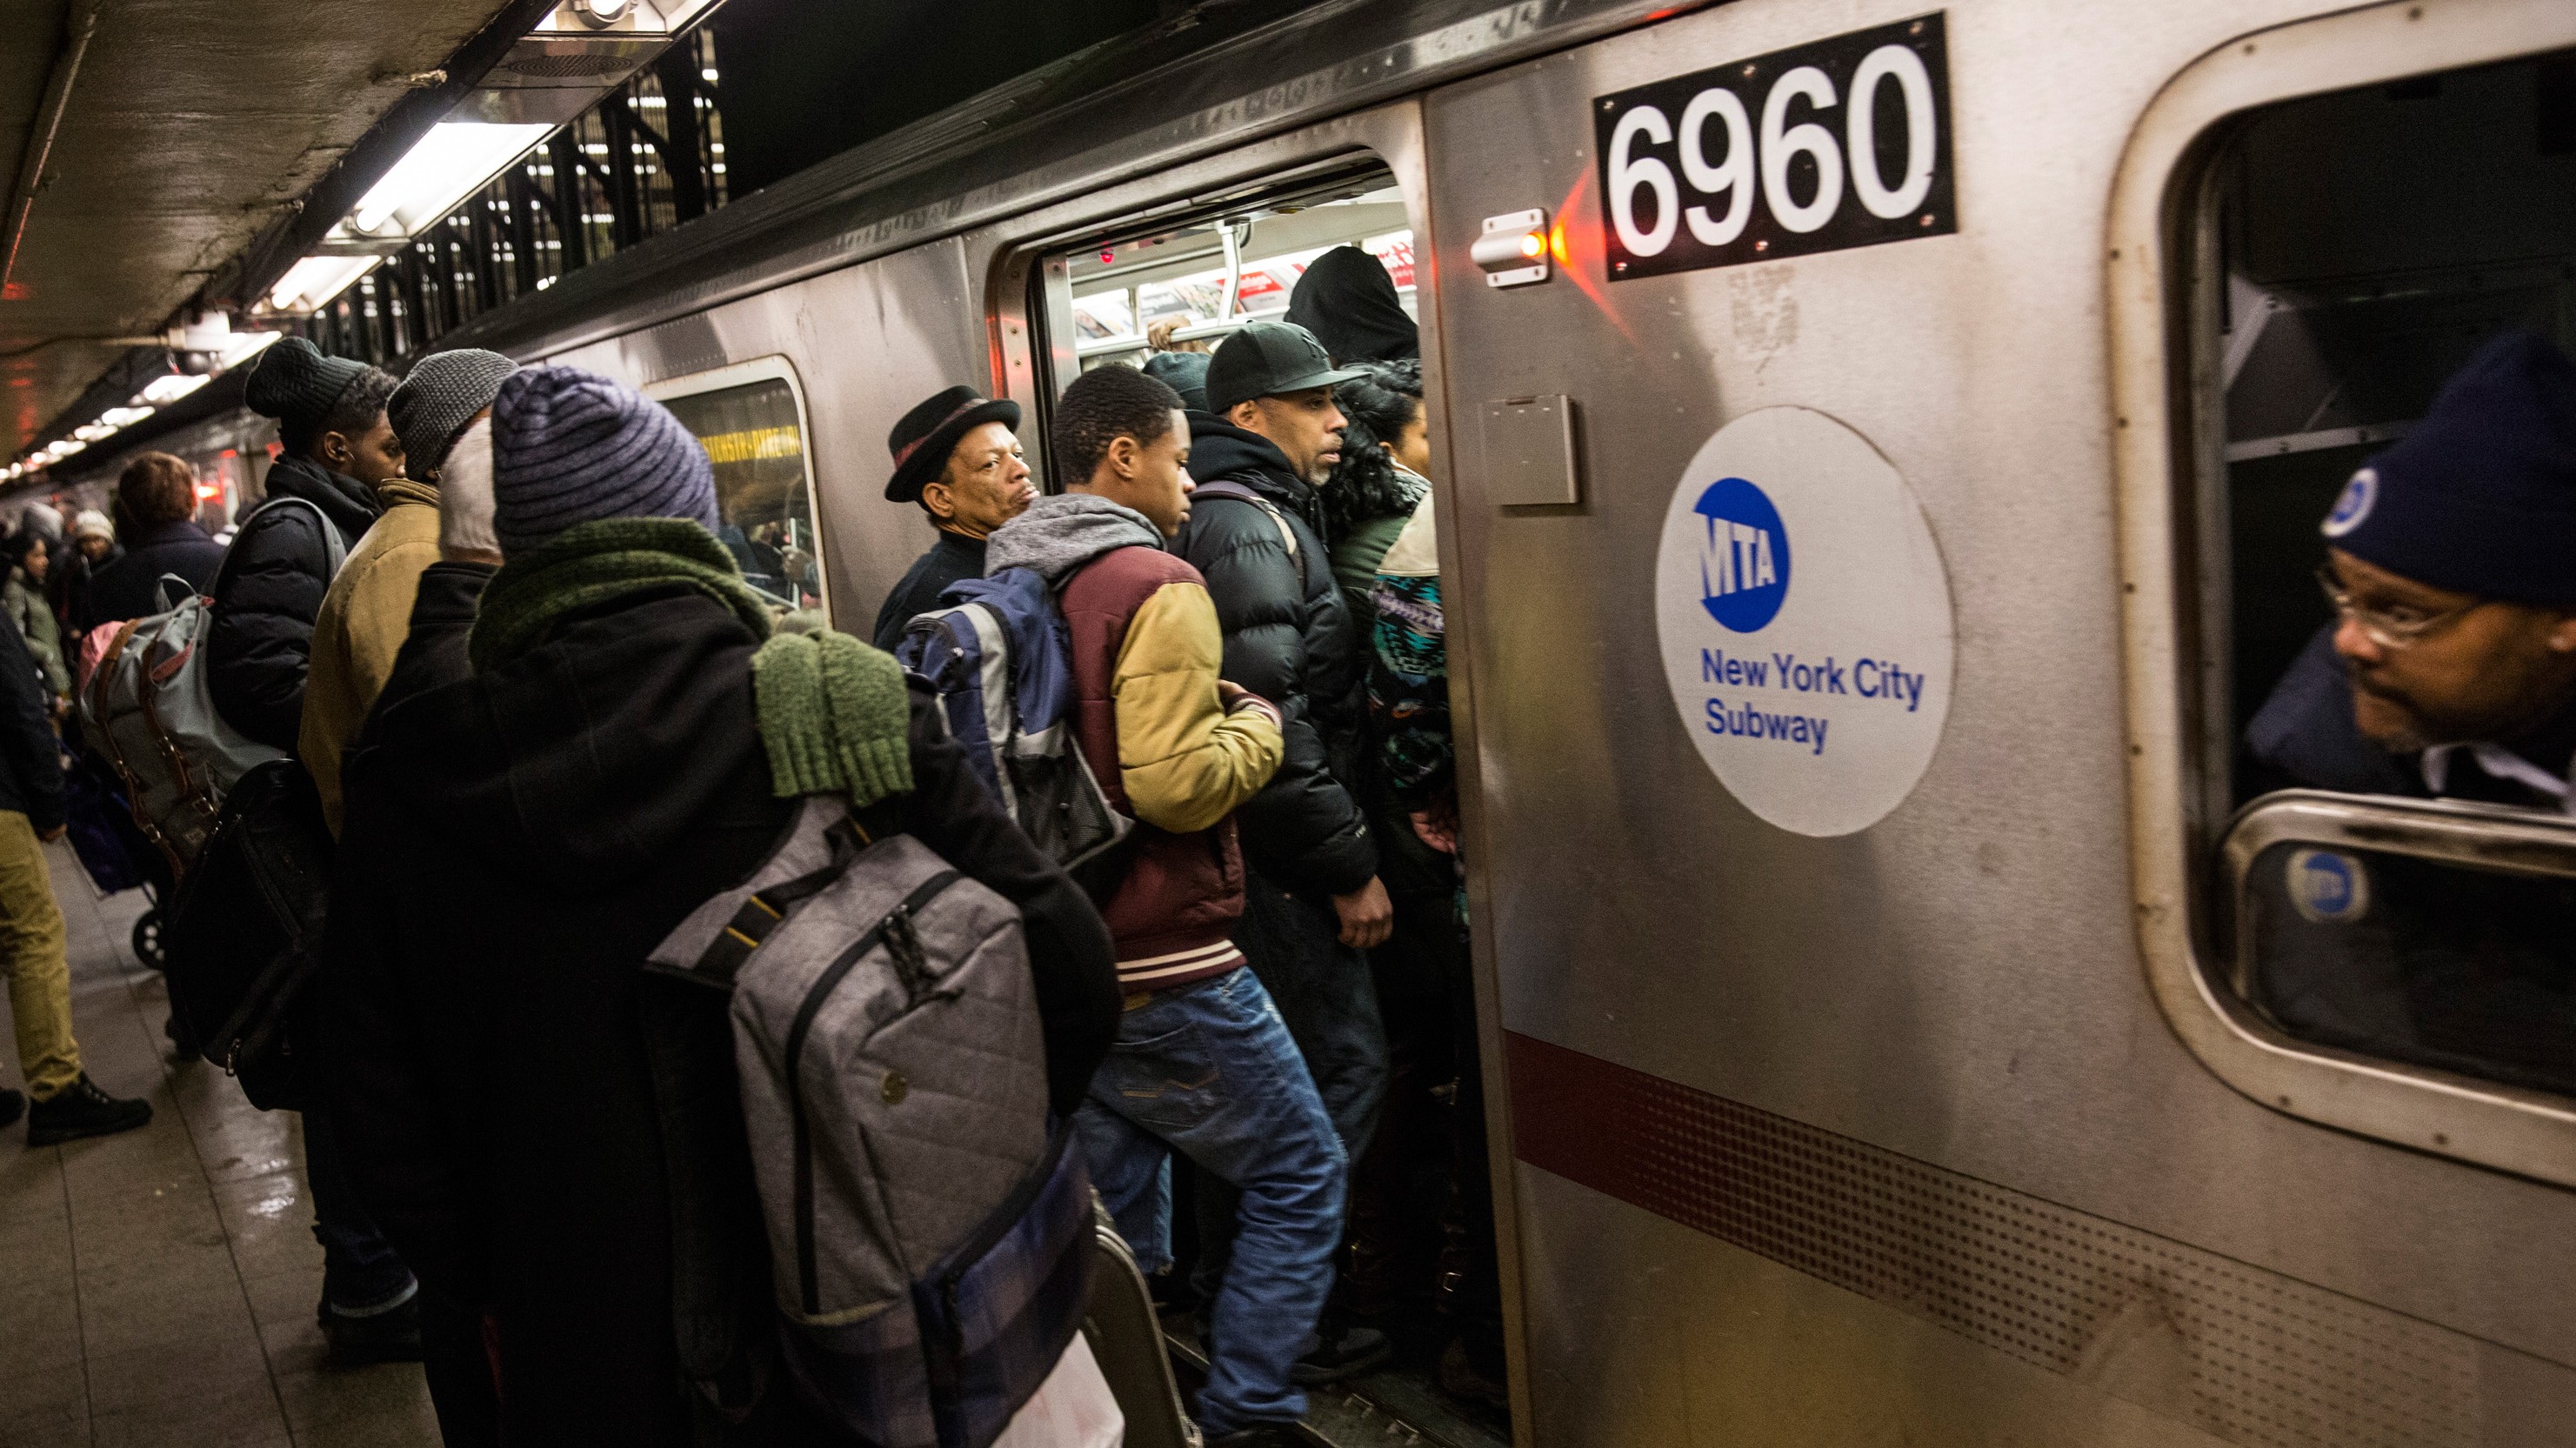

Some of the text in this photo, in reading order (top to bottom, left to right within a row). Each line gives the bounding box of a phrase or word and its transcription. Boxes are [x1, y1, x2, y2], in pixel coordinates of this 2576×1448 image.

[1608, 43, 1936, 257] 6960
[1699, 514, 1777, 599] MTA
[1701, 648, 1925, 712] New York City
[1705, 697, 1828, 755] Subway
